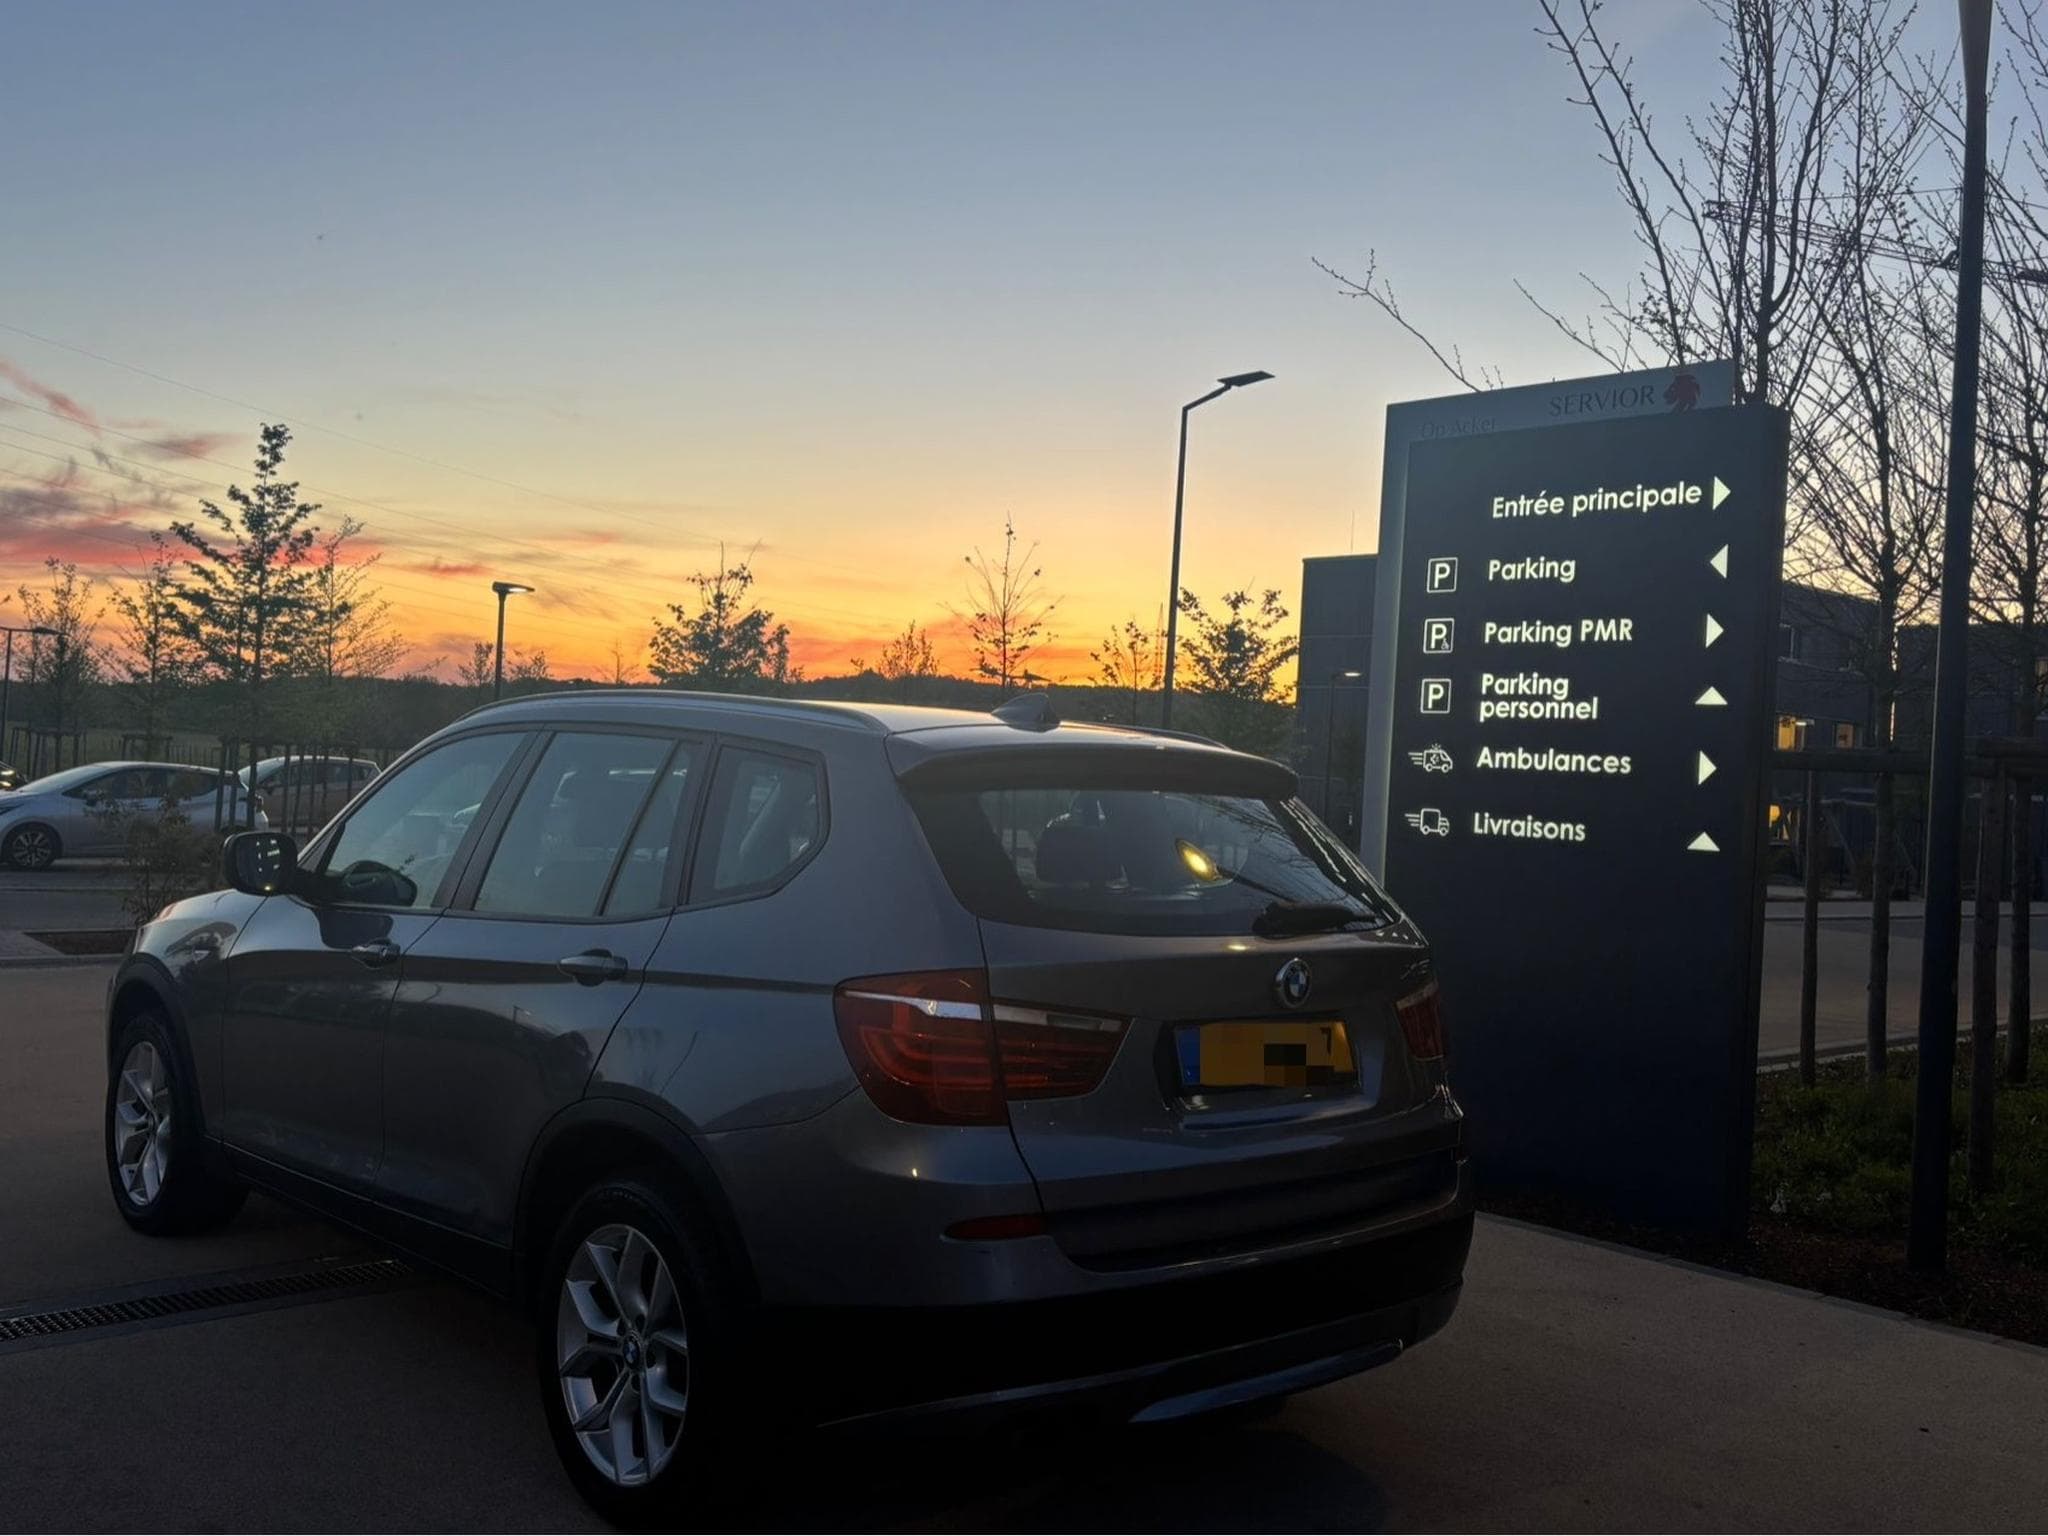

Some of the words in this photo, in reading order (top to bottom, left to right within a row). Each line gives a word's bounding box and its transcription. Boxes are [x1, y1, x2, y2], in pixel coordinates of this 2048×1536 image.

[1549, 385, 1656, 417] SERVIOR
[1492, 490, 1566, 518] Entrée
[1571, 481, 1703, 517] principale
[1488, 556, 1577, 584] Parking
[1485, 620, 1573, 649] Parking
[1580, 618, 1633, 642] PMR
[1481, 672, 1570, 700] Parking
[1479, 697, 1599, 723] personnel
[1476, 747, 1632, 775] Ambulances
[1473, 812, 1586, 842] Livraisons
